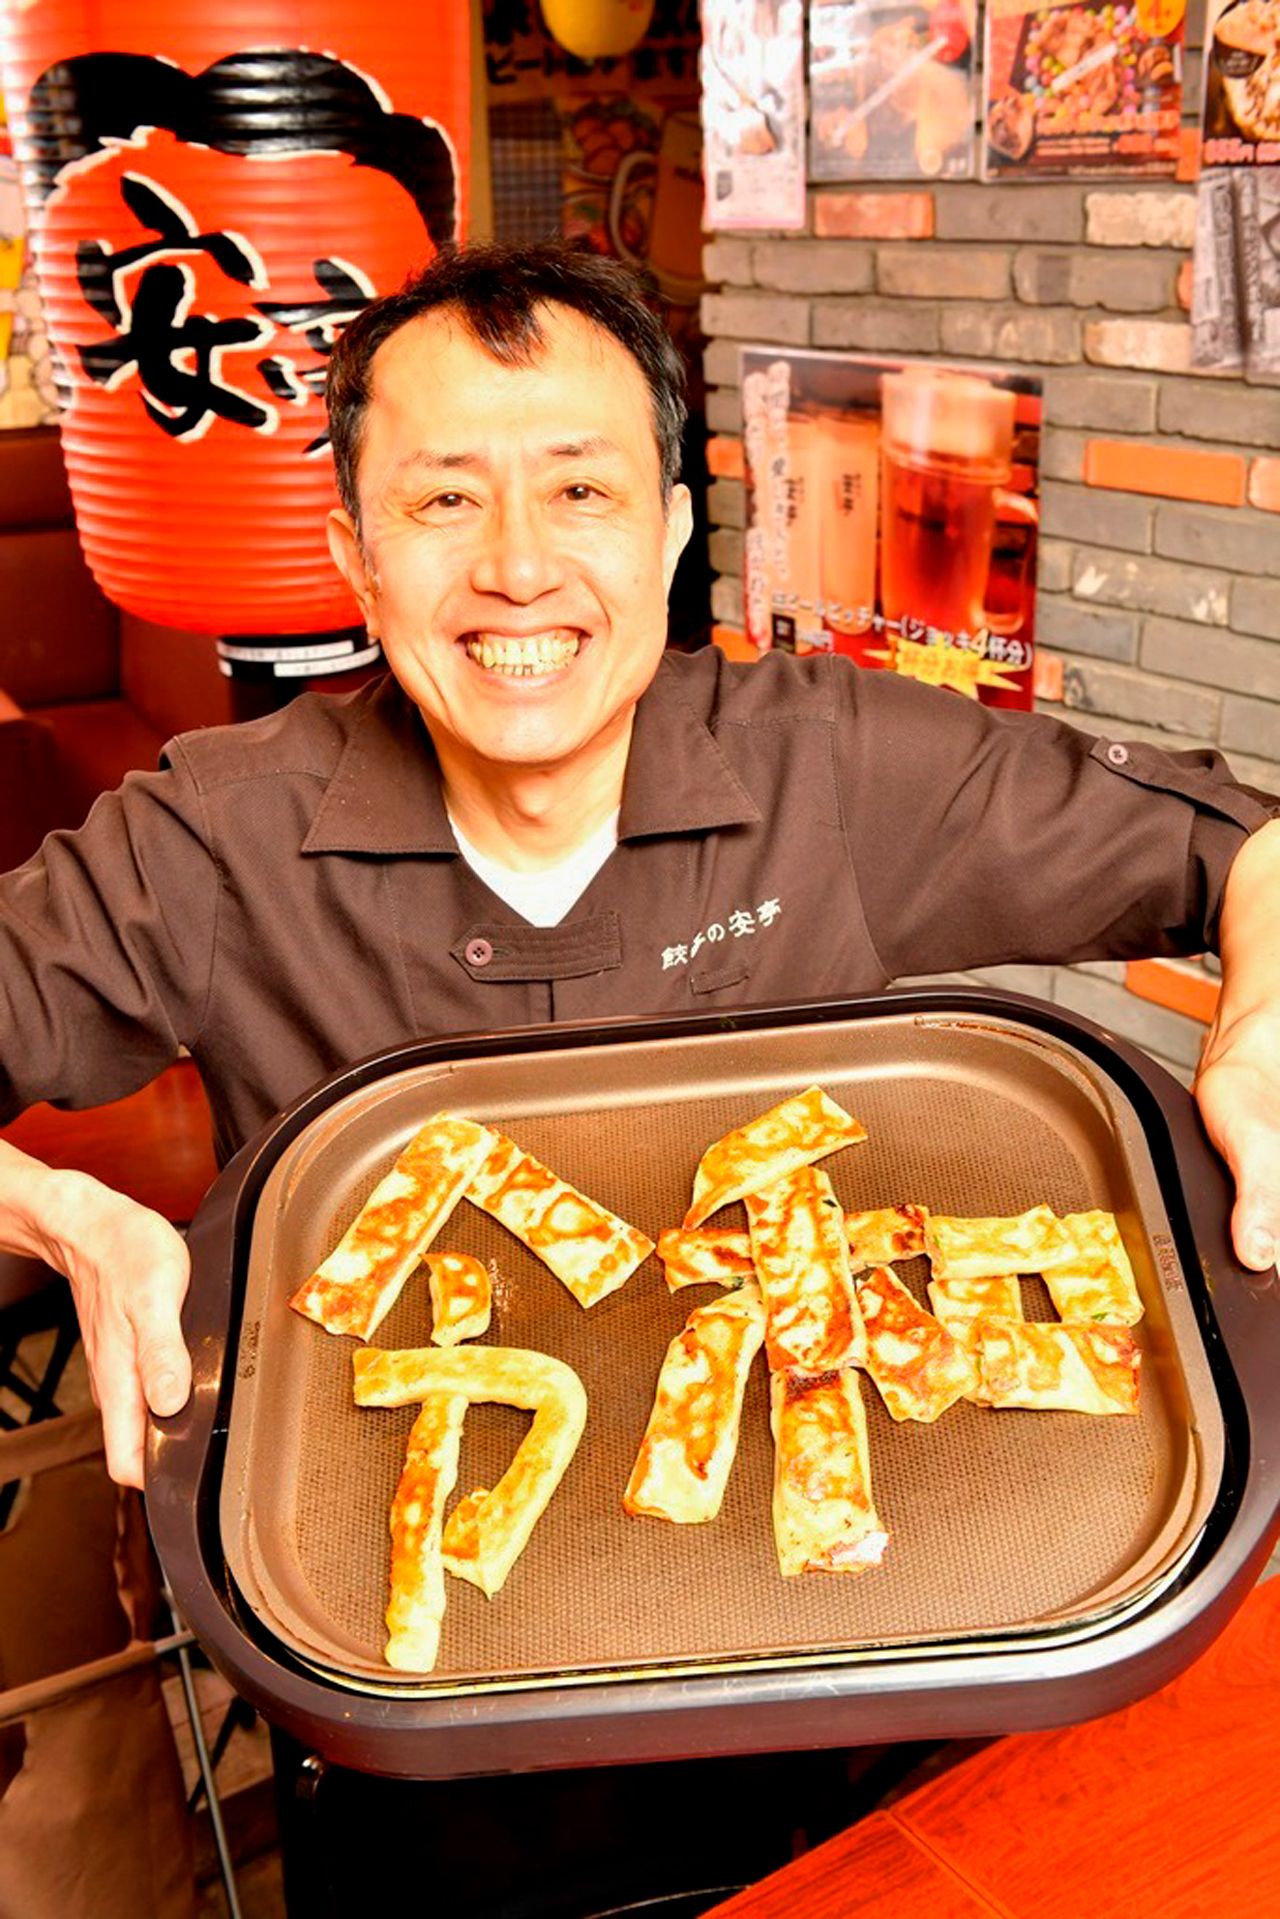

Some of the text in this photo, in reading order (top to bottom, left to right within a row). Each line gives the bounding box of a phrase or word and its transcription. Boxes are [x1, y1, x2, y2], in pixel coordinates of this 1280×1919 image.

[661, 897, 782, 971] 餃子の安亭
[288, 1084, 1146, 1674] 令和
